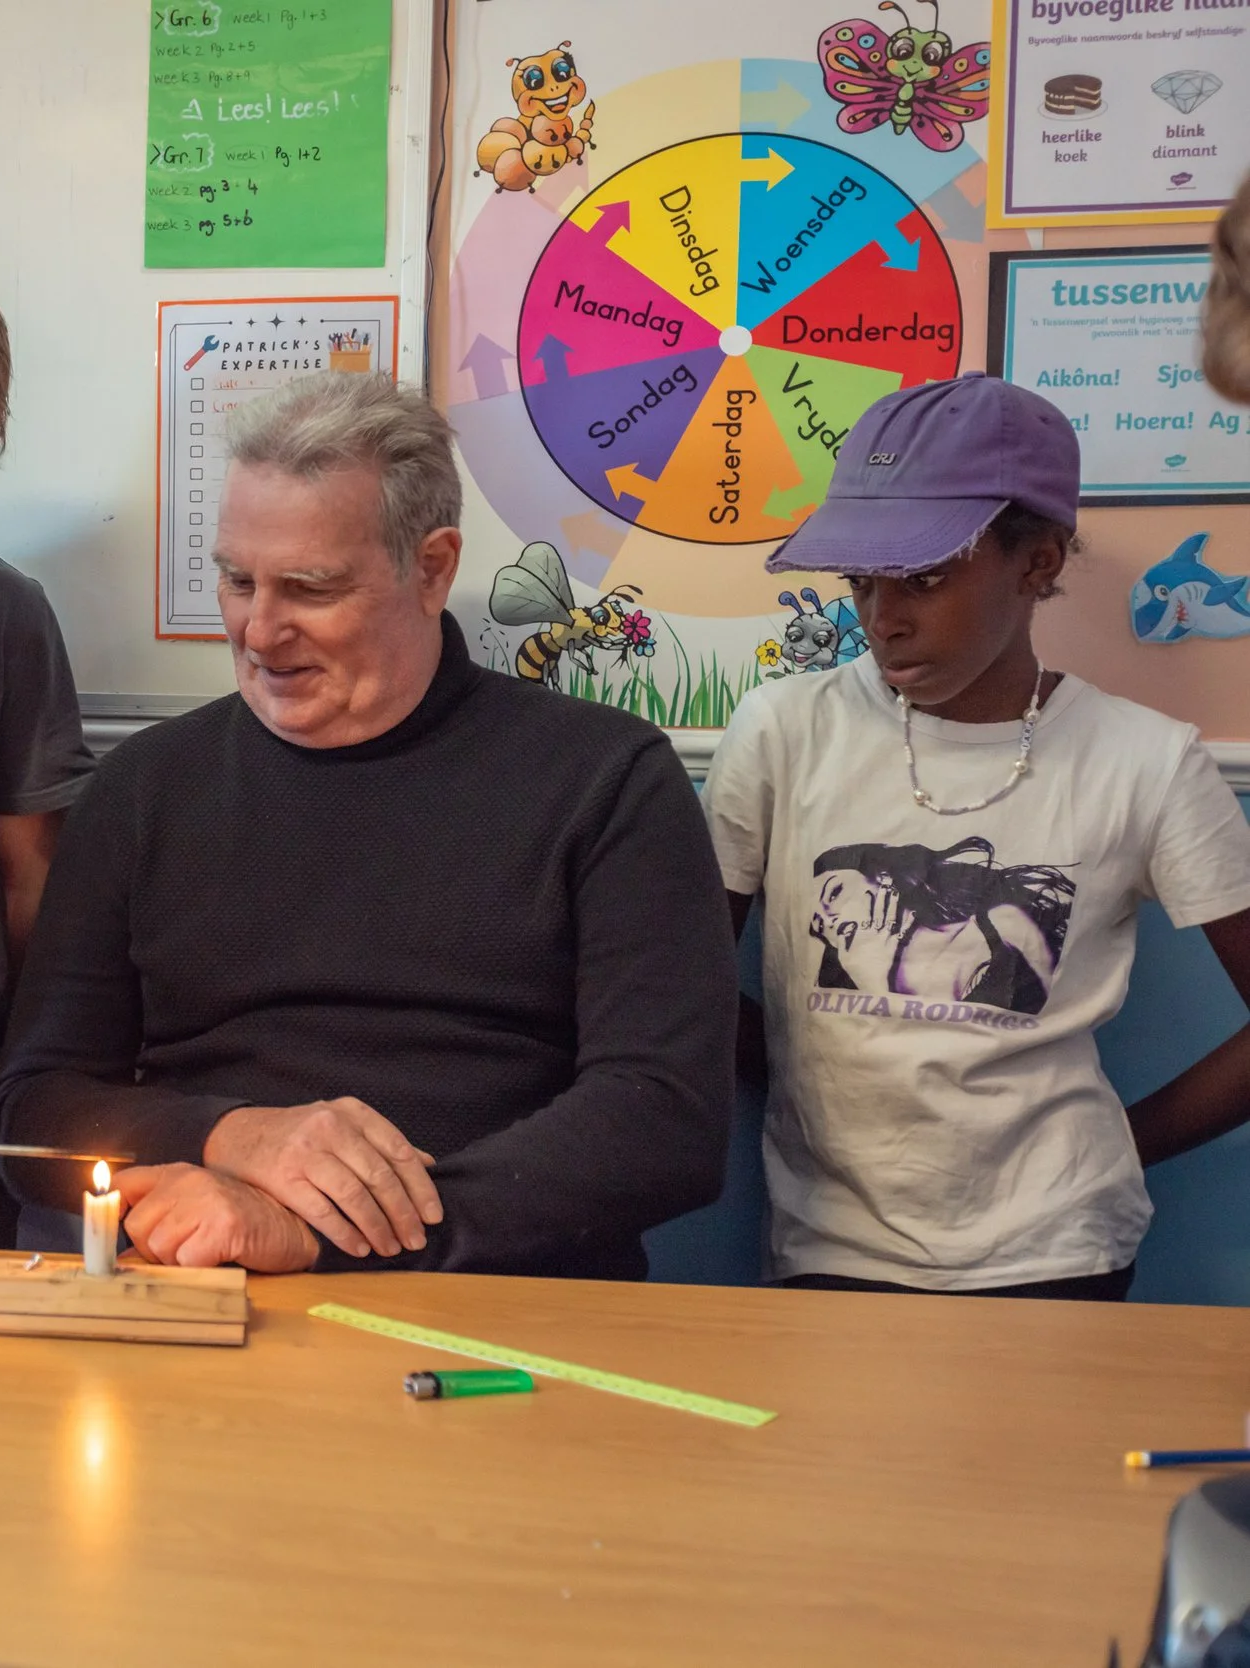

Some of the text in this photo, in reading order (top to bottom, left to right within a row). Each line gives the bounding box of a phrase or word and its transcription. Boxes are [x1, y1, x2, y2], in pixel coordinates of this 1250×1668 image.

[1041, 128, 1103, 145] heerlike
[1165, 124, 1206, 139] blink
[1054, 149, 1088, 163] koek
[1152, 144, 1218, 159] diamant
[659, 185, 720, 297] Dinsdag
[741, 175, 868, 295] Woensdag
[554, 280, 685, 348] Maandag
[783, 312, 955, 352] Donderdag
[222, 339, 321, 354] PATRICK'S
[220, 358, 322, 371] EXPERTISE
[1036, 367, 1121, 388] Aikôna!
[587, 364, 699, 450] Sondag
[1115, 411, 1194, 431] Hoera!
[709, 388, 757, 525] Saterdag
[806, 991, 892, 1018] OLIVIA
